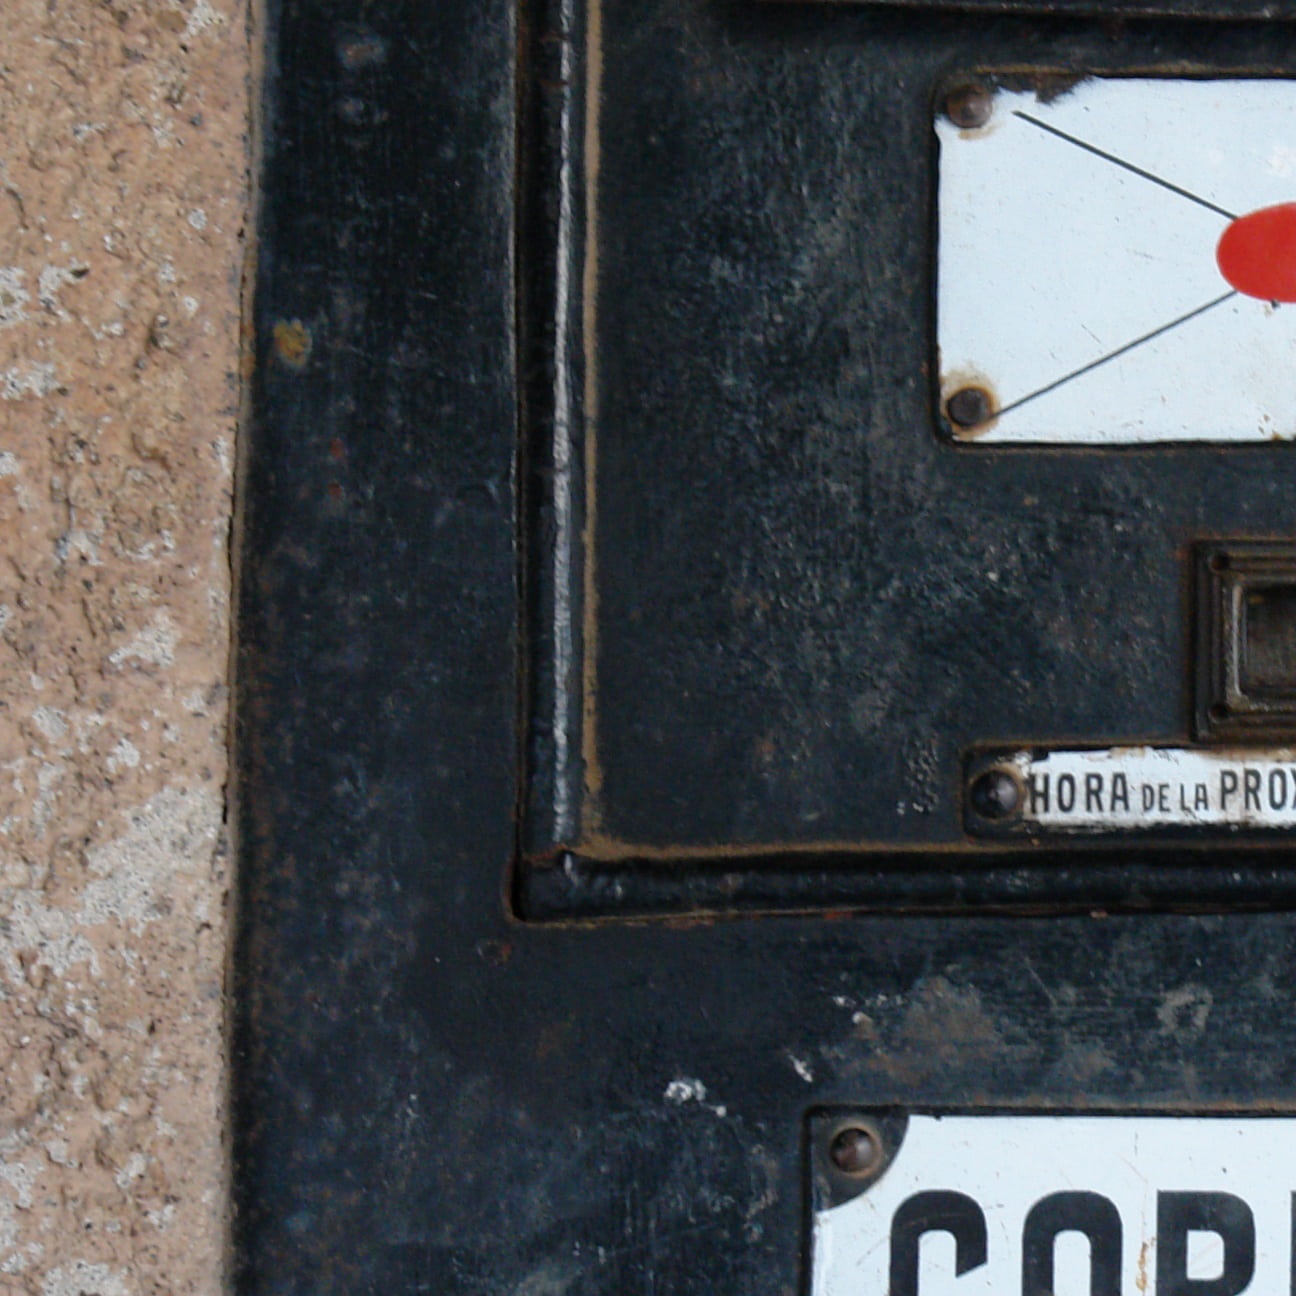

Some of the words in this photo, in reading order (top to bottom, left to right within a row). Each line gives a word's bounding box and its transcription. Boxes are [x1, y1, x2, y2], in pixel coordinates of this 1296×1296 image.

[1027, 771, 1130, 814] HORA
[1141, 782, 1170, 812] DE
[1178, 781, 1209, 811] LA
